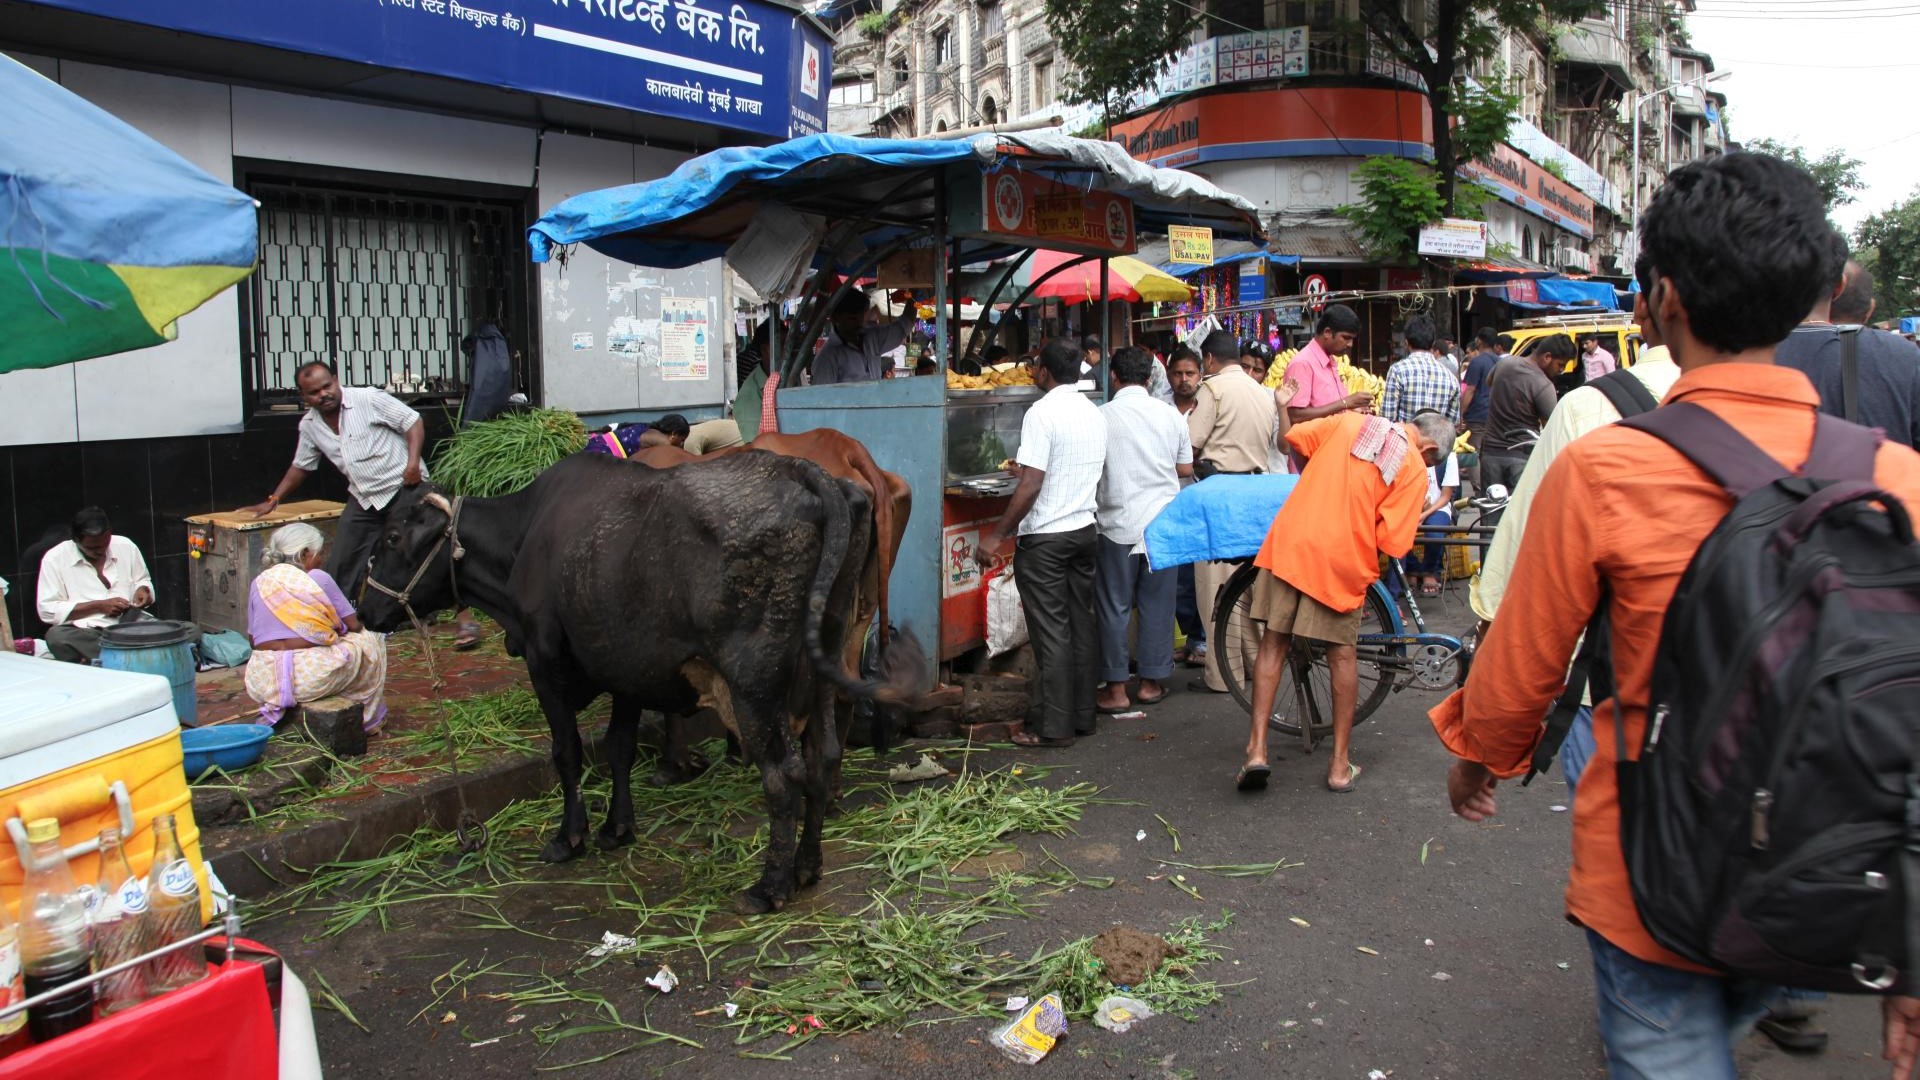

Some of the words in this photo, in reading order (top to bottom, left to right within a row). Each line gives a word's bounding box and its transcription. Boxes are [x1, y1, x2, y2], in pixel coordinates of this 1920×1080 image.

[728, 4, 765, 55] लि.
[645, 78, 704, 104] कालबादेवी
[707, 88, 731, 112] मुंबई
[735, 96, 763, 116] शाखा
[1175, 251, 1193, 260] USAL
[1196, 252, 1210, 260] PAV
